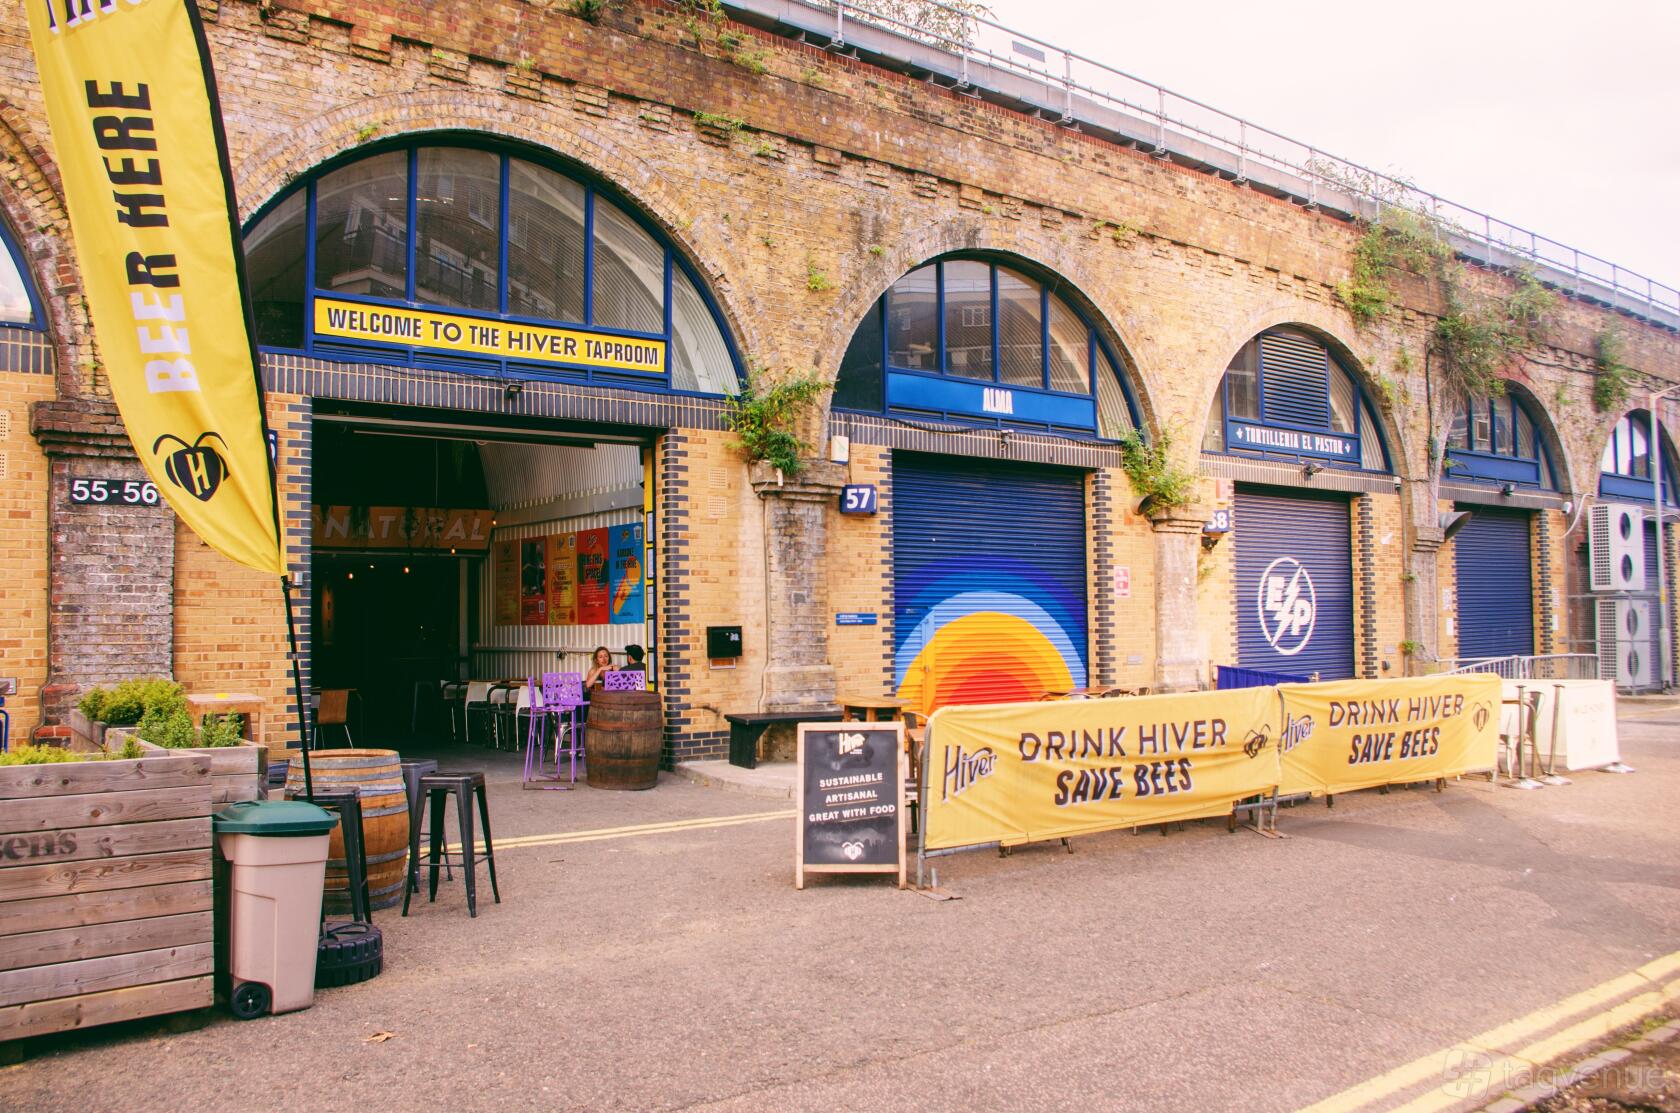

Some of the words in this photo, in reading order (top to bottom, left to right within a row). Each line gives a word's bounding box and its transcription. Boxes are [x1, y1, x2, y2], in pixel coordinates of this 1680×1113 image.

[85, 80, 169, 227] HERE
[126, 251, 201, 394] BEER
[327, 307, 423, 339] WELCOME
[430, 320, 464, 343] TO
[469, 325, 500, 348] THE
[507, 330, 578, 357] HIVER
[584, 339, 659, 366] TAPROOM
[1245, 426, 1299, 449] TORTILLERIA
[1302, 434, 1313, 450] EL
[1315, 436, 1344, 454] PASTOR
[846, 487, 871, 509] 57
[1329, 698, 1400, 727] DRINK
[1408, 694, 1464, 722] HIVER
[1018, 726, 1127, 762] DRINK
[1138, 718, 1227, 755] HIVER
[1348, 730, 1396, 765] SAVE
[1400, 726, 1440, 759] BEES
[819, 772, 883, 788] SUSTAINABLE
[942, 745, 997, 803] Hiver
[1054, 766, 1123, 807] SAVE
[1134, 757, 1193, 798] BEES
[808, 812, 839, 822] GREAT
[842, 808, 867, 818] WITH
[870, 804, 896, 815] FOOD
[825, 790, 878, 804] ARTISANAL
[0, 831, 77, 860] en's
